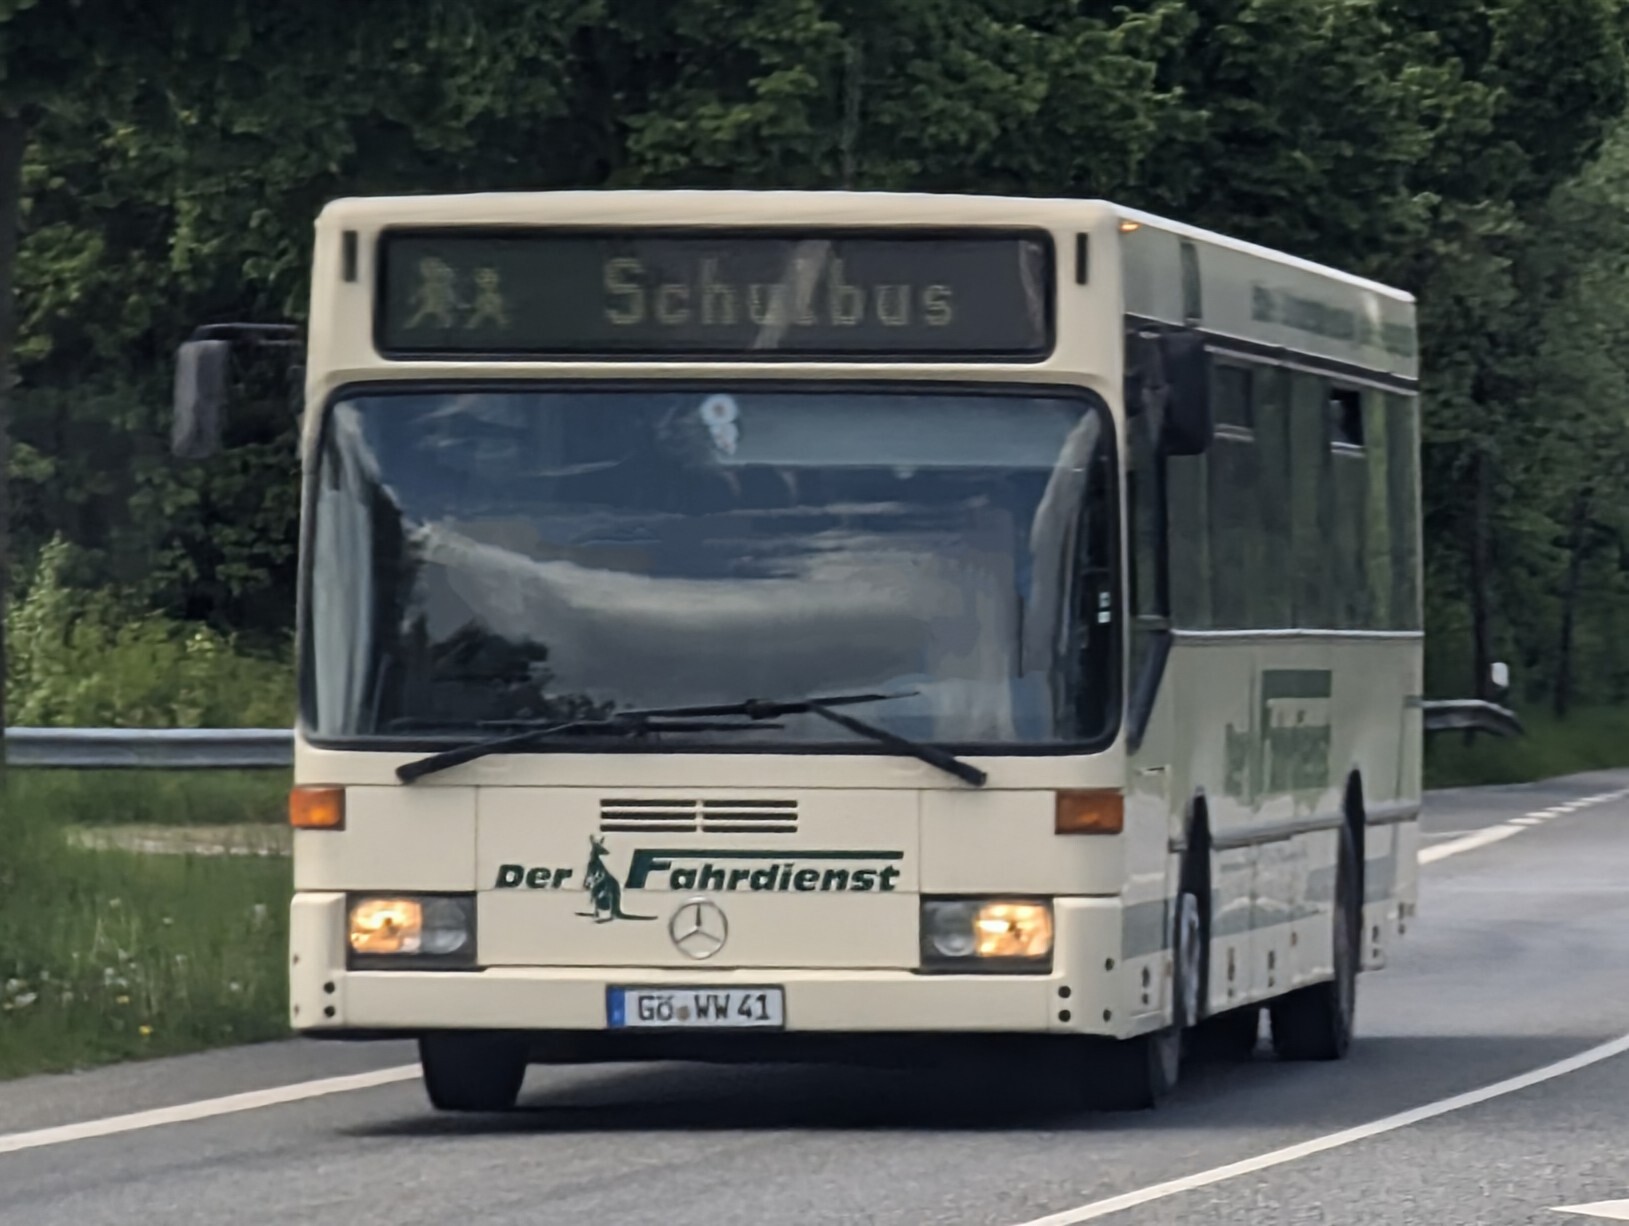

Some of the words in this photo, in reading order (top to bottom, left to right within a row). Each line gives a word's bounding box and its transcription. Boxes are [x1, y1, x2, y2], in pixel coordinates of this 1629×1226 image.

[604, 257, 953, 327] Schulbus
[494, 863, 573, 889] Der
[625, 848, 904, 892] Fahrdienst
[694, 993, 730, 1021] WW
[737, 993, 770, 1021] 41
